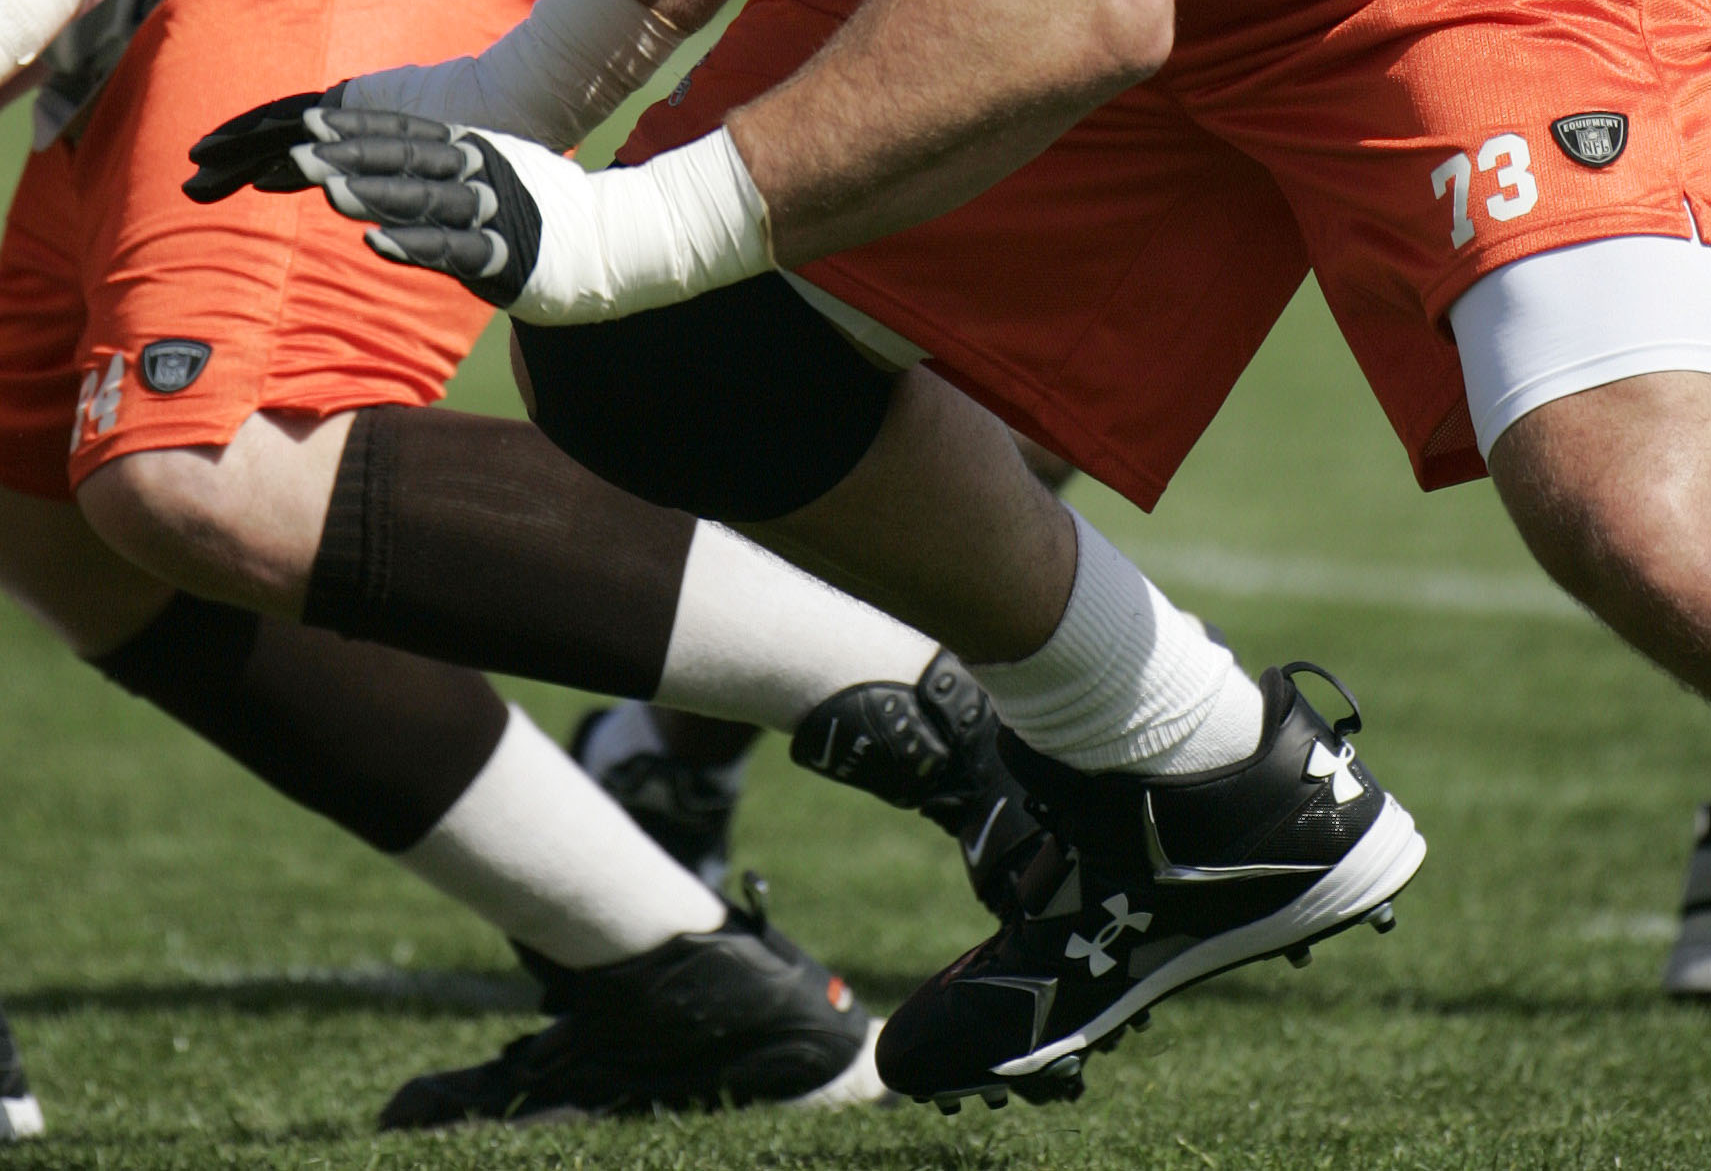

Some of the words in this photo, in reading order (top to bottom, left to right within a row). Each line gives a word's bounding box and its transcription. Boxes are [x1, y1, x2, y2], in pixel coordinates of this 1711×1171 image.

[1563, 118, 1619, 133] EQUIPMENT
[1580, 139, 1611, 156] NFL
[1431, 133, 1538, 250] 73
